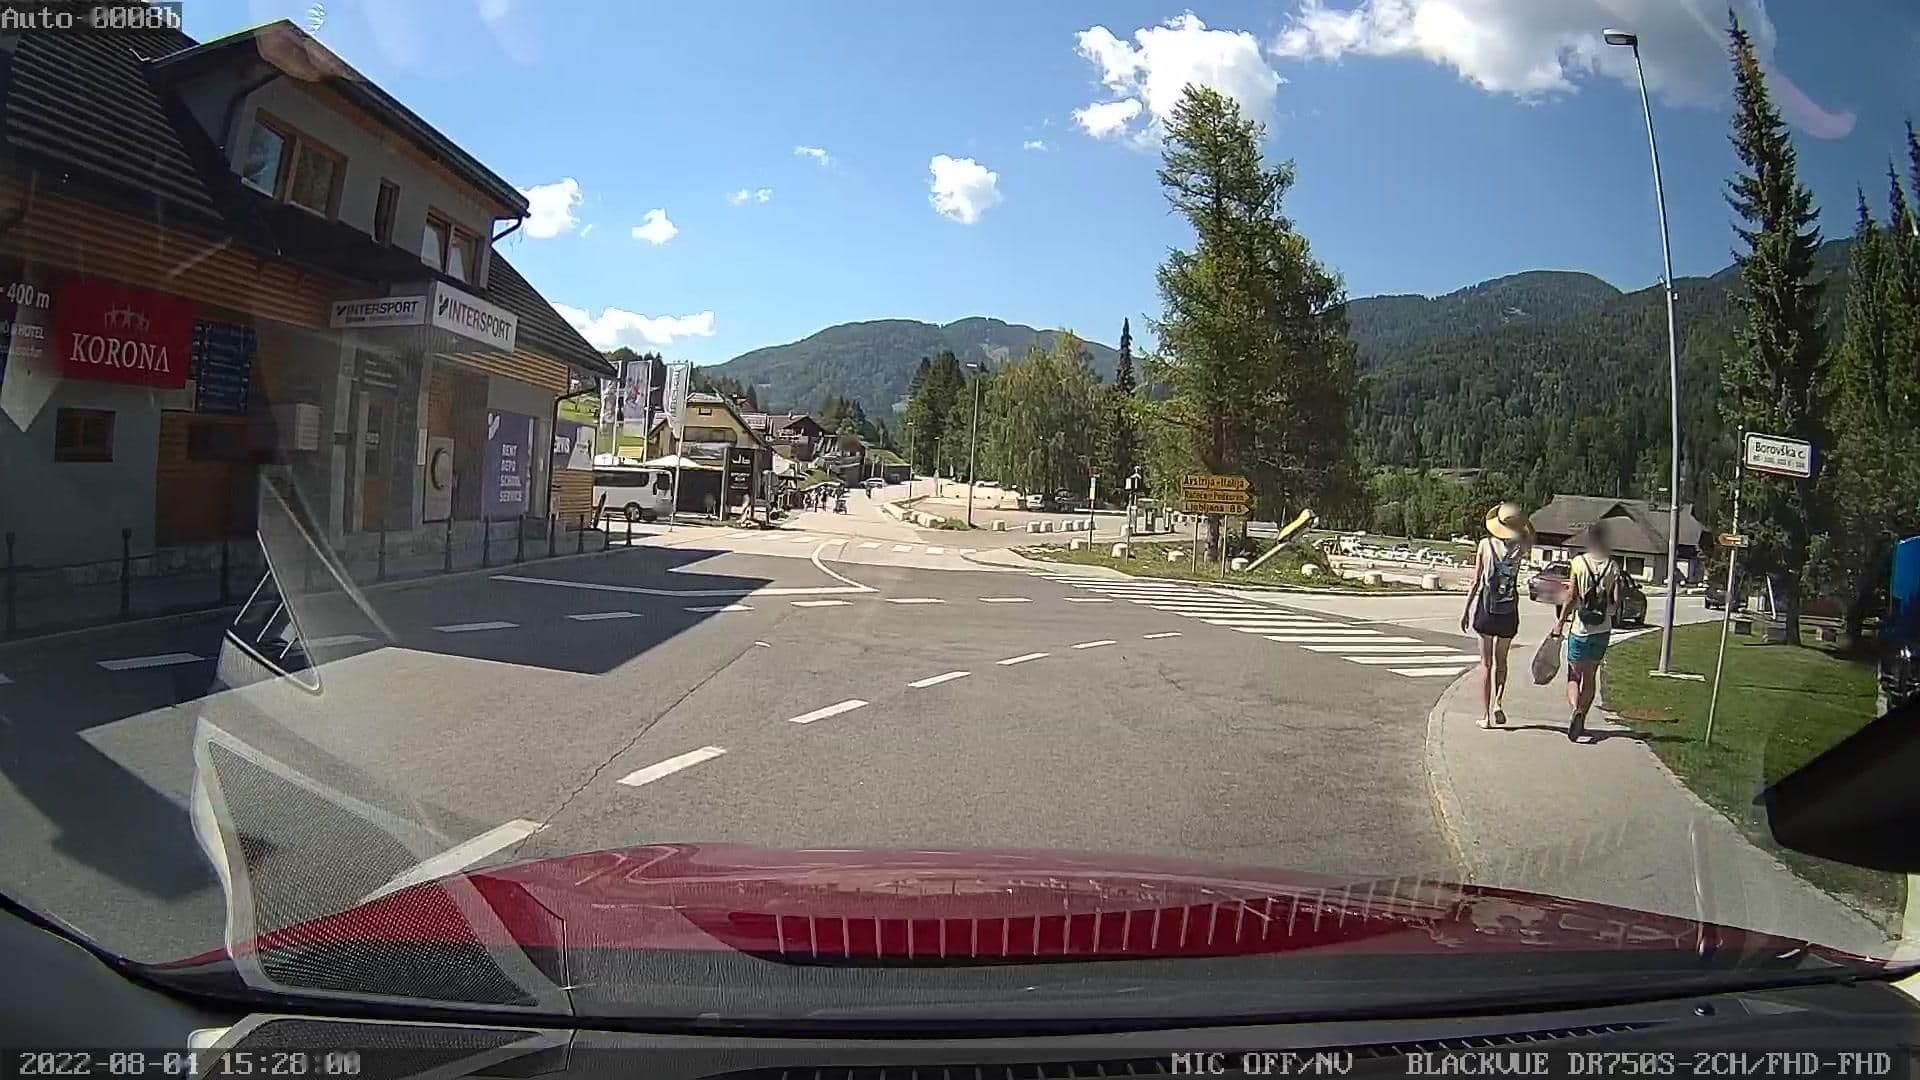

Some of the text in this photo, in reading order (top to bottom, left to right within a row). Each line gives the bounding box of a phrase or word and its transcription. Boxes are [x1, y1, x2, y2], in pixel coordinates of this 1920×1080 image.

[7, 283, 50, 309] 400 m
[346, 301, 418, 316] INTERSPORT
[448, 297, 512, 341] INTERSPORT
[70, 332, 170, 373] KORONA
